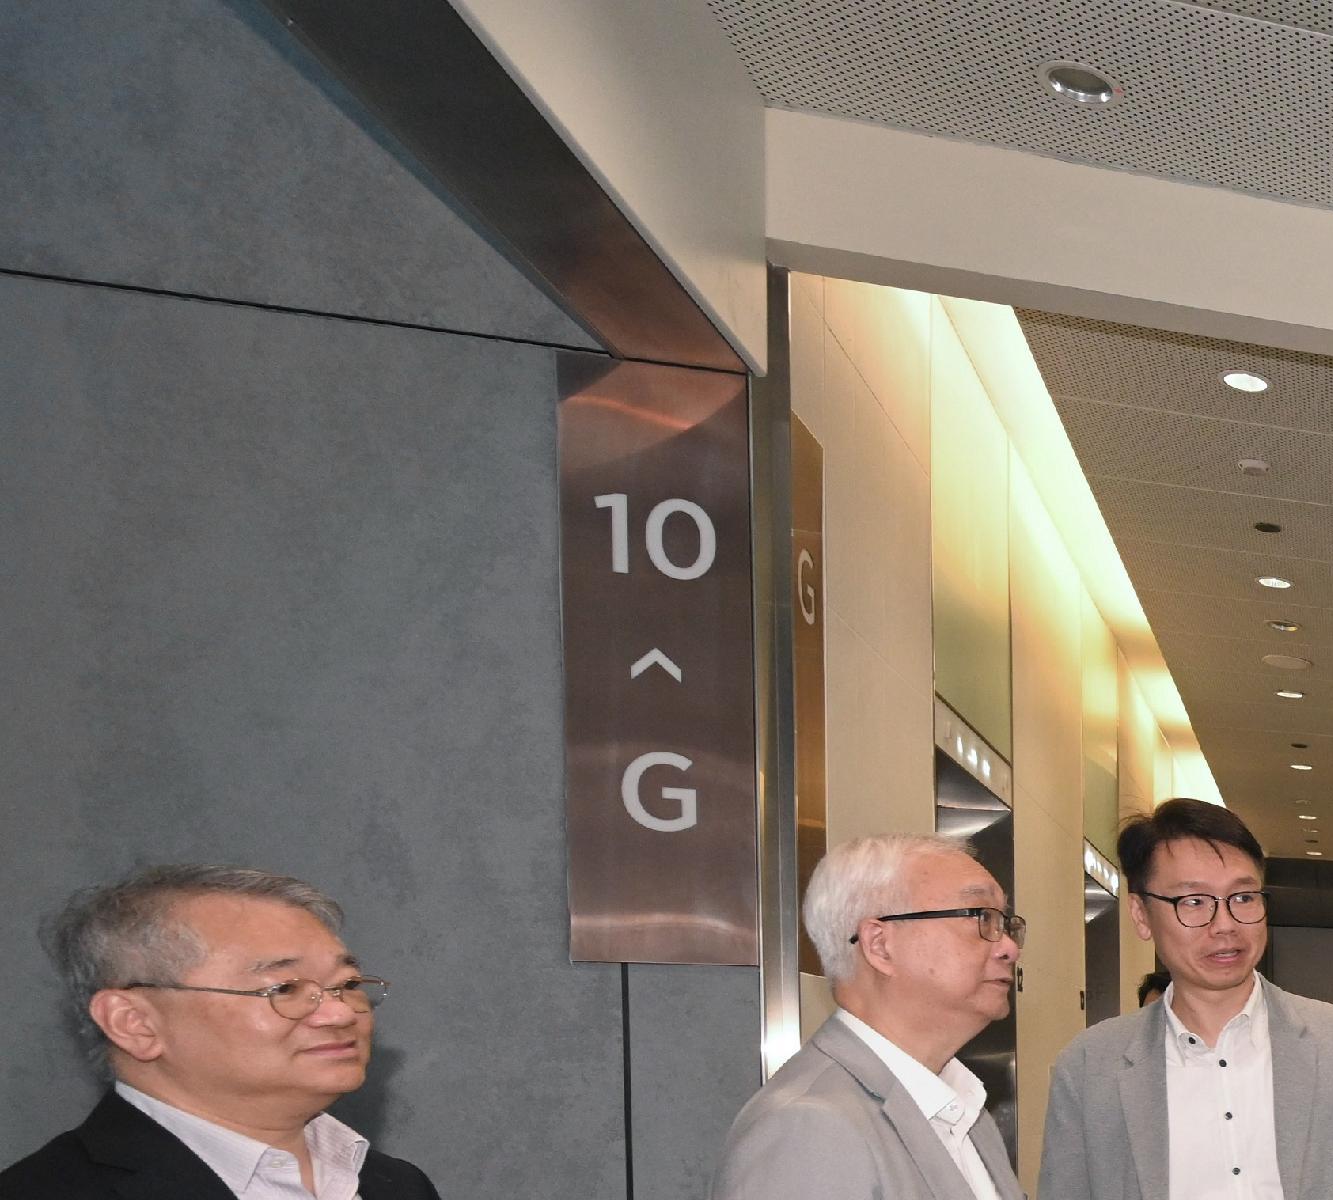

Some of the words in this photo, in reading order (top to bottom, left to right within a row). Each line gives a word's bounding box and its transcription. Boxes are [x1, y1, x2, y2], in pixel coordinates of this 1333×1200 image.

[594, 492, 717, 581] 10
[797, 549, 815, 626] G
[620, 750, 698, 833] G
